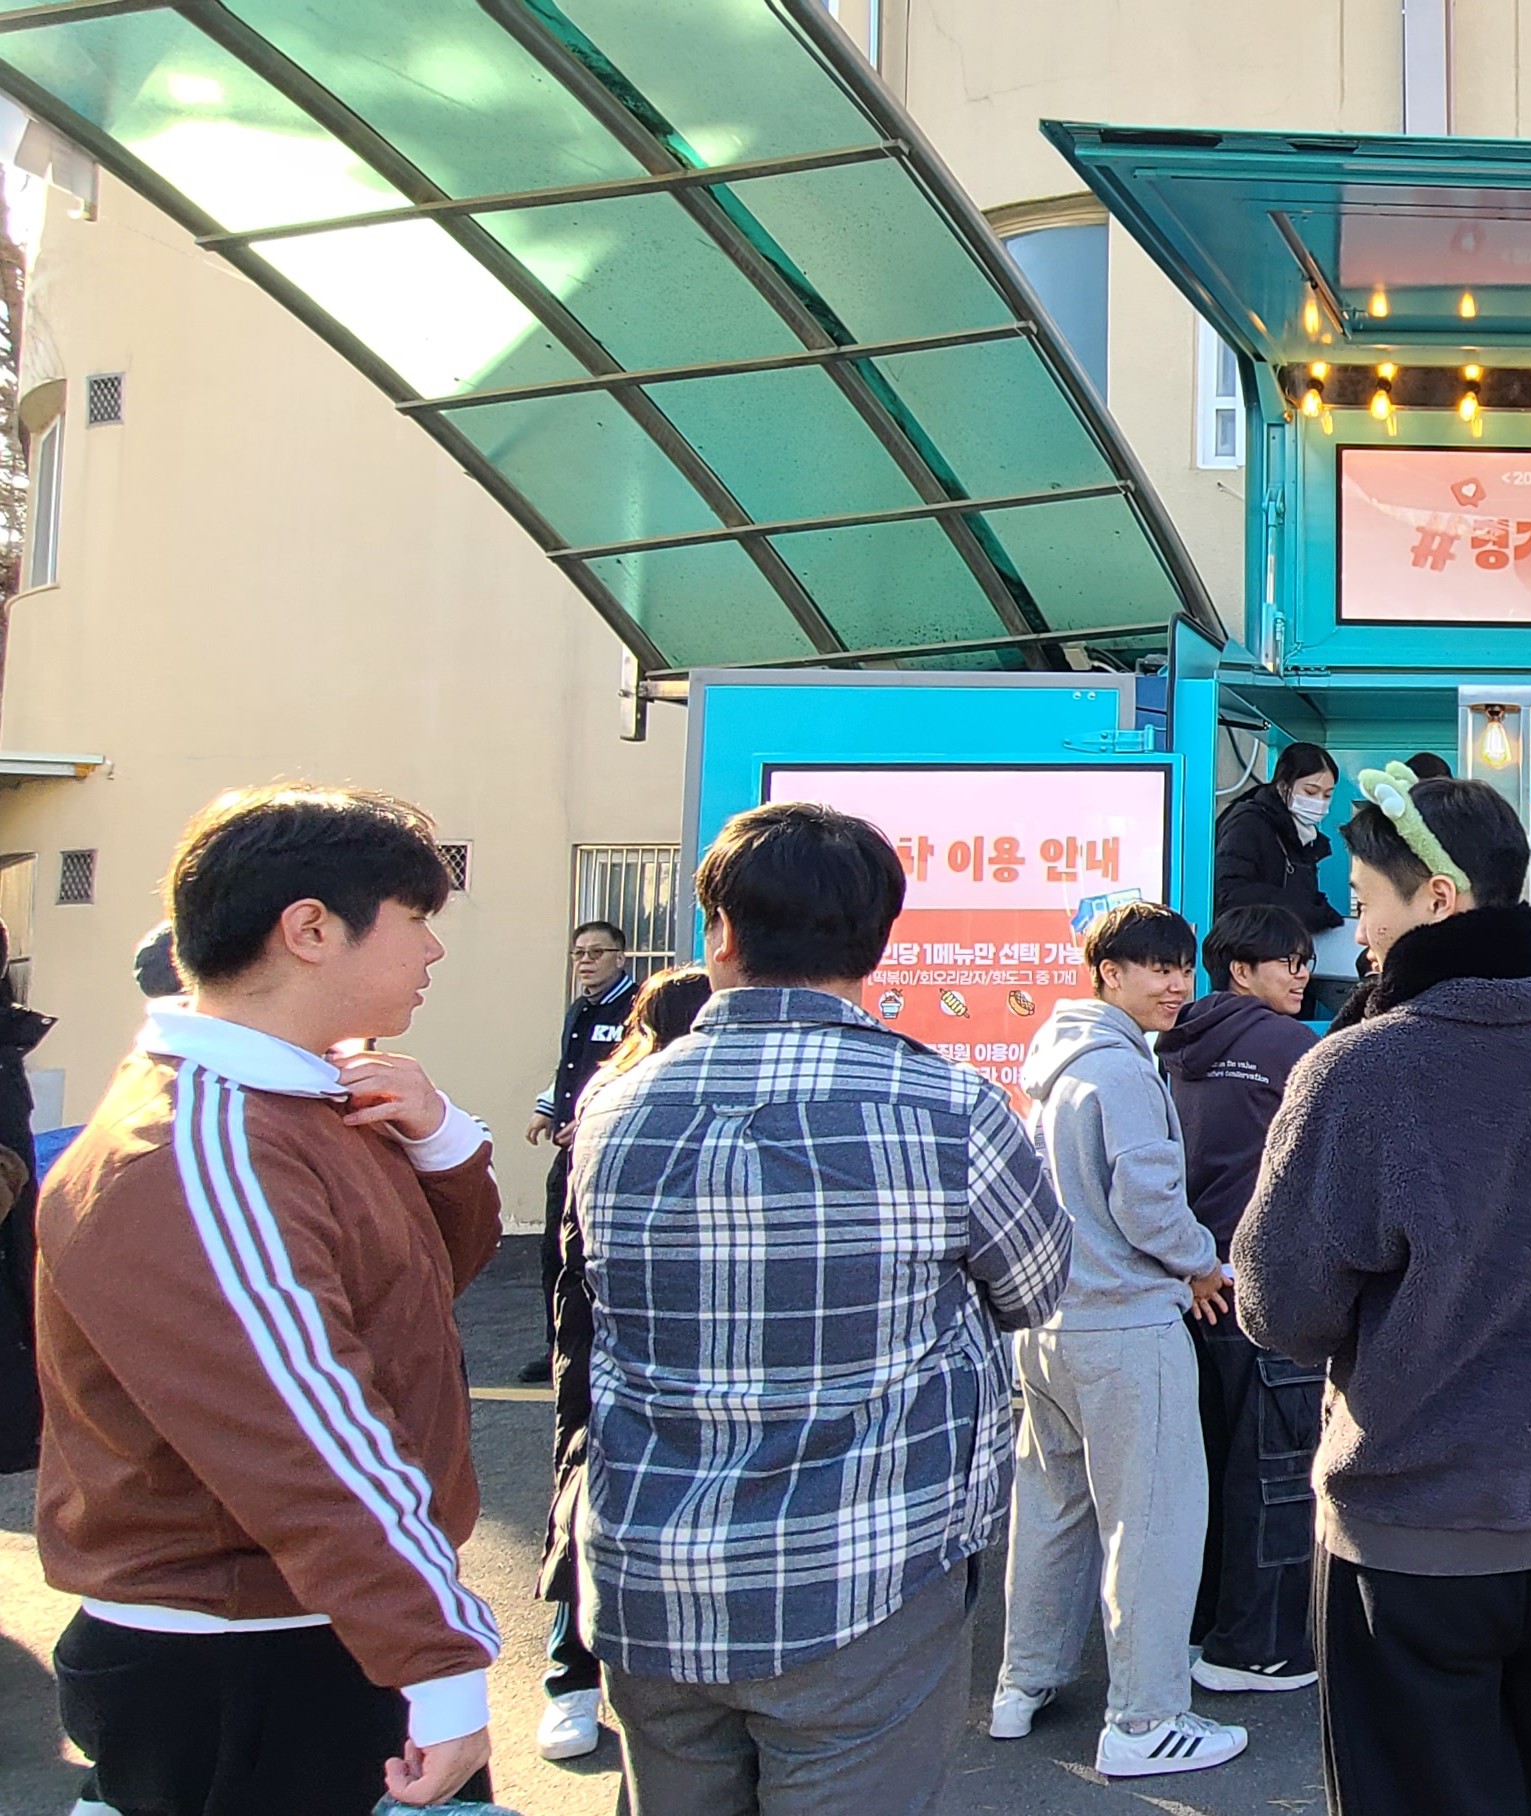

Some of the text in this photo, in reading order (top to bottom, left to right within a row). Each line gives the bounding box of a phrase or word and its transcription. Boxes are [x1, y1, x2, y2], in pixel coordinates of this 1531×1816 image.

[947, 836, 1026, 883] 이용
[1039, 836, 1120, 883] 안내
[923, 942, 996, 966] 1메뉴만
[999, 942, 1039, 966] 선택
[1036, 970, 1050, 985] 중
[1053, 970, 1077, 986] 1개]
